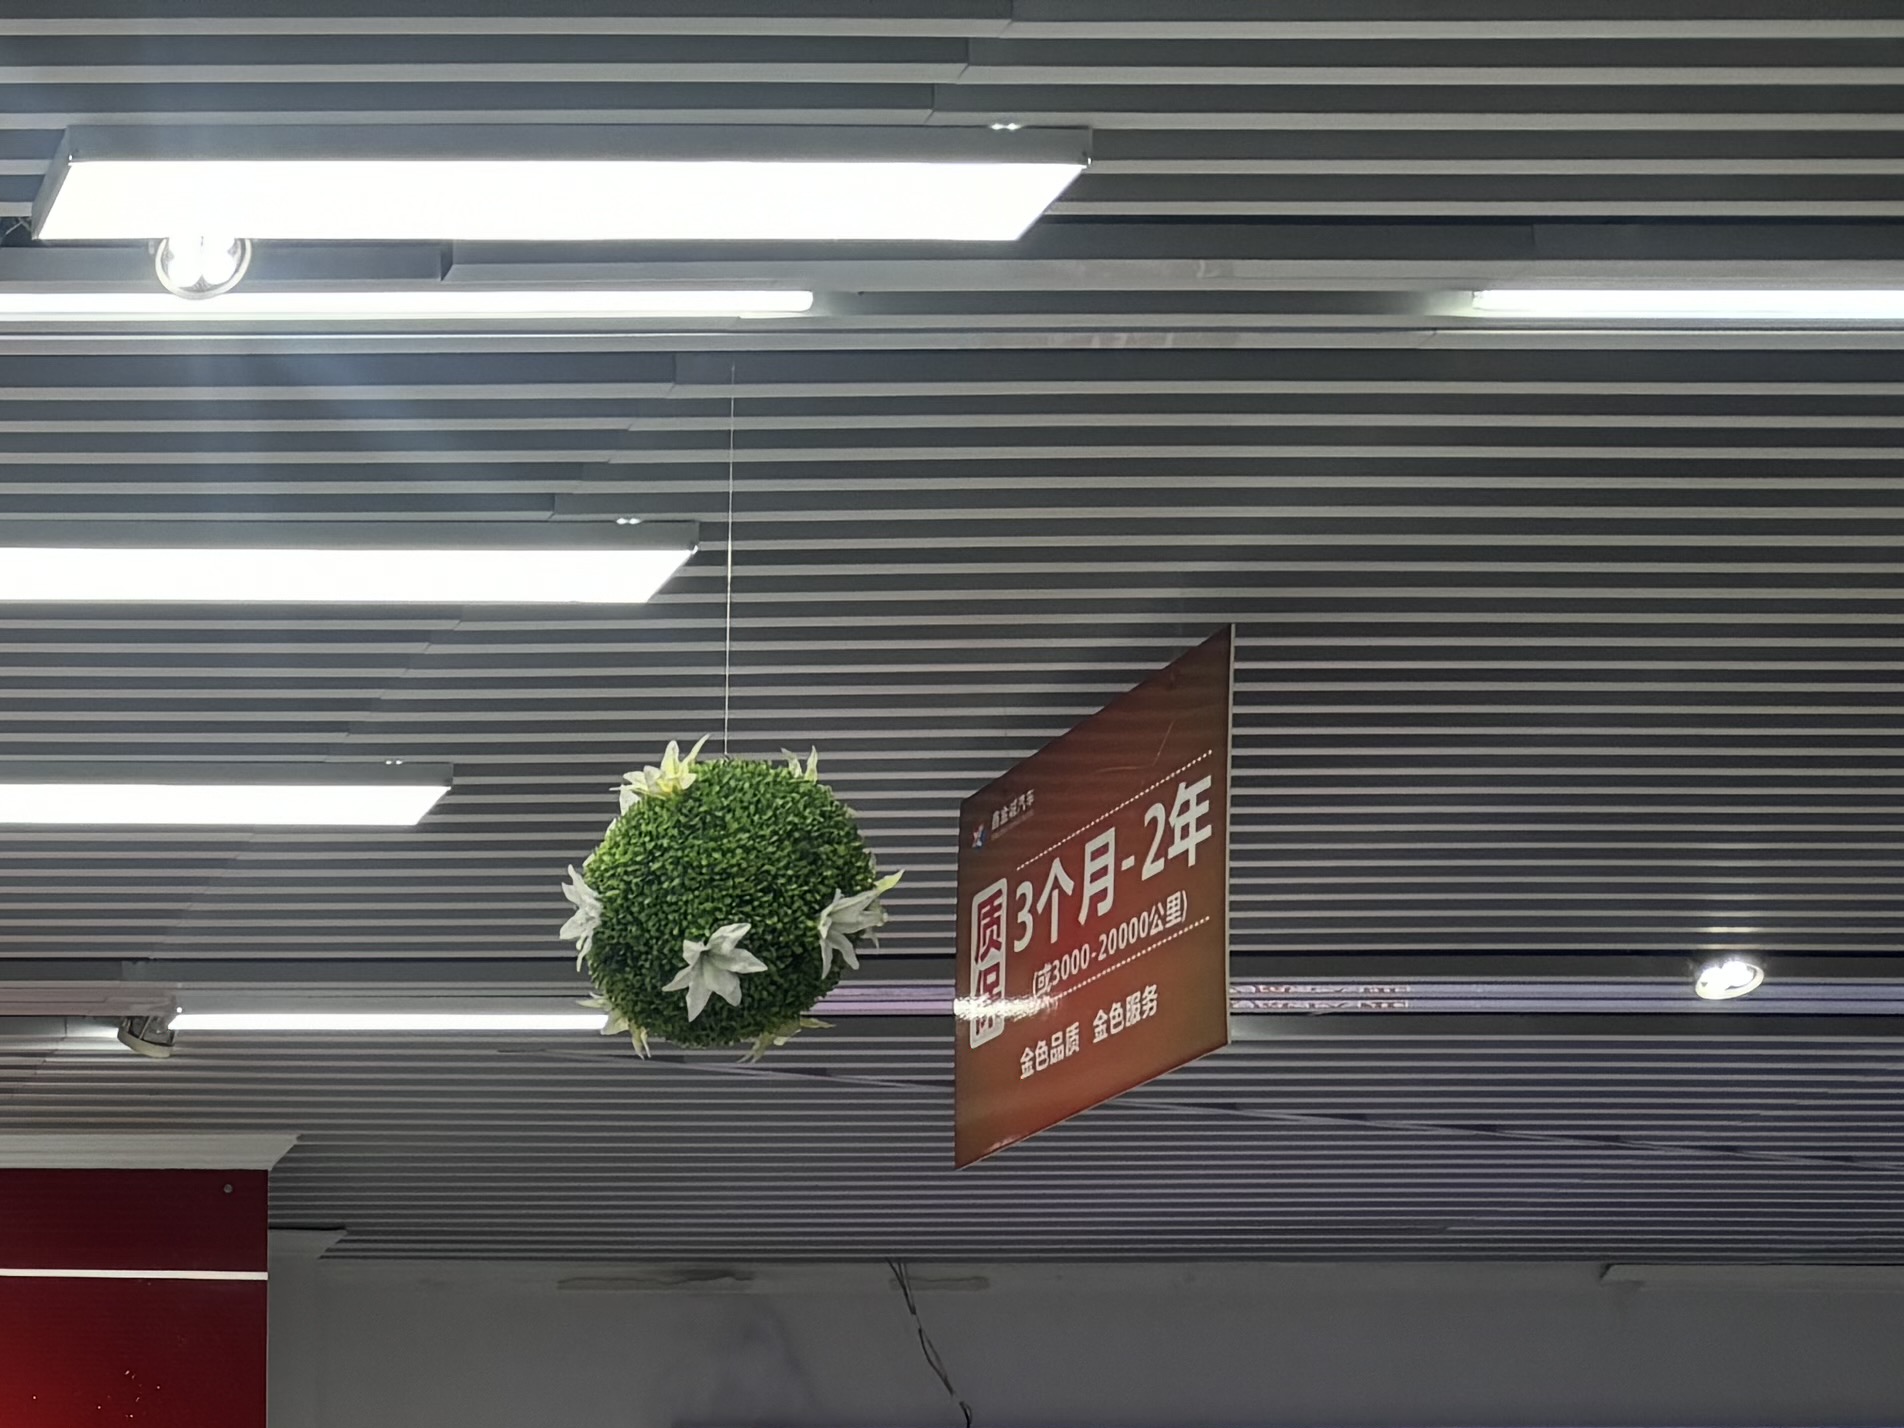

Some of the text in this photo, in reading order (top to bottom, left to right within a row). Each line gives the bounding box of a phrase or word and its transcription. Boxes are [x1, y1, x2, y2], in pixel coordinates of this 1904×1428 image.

[1013, 774, 1212, 953] 3个月-2年
[1031, 889, 1188, 997] (或3000-20000公里)
[1019, 983, 1158, 1081] 金色品质 金色服务
